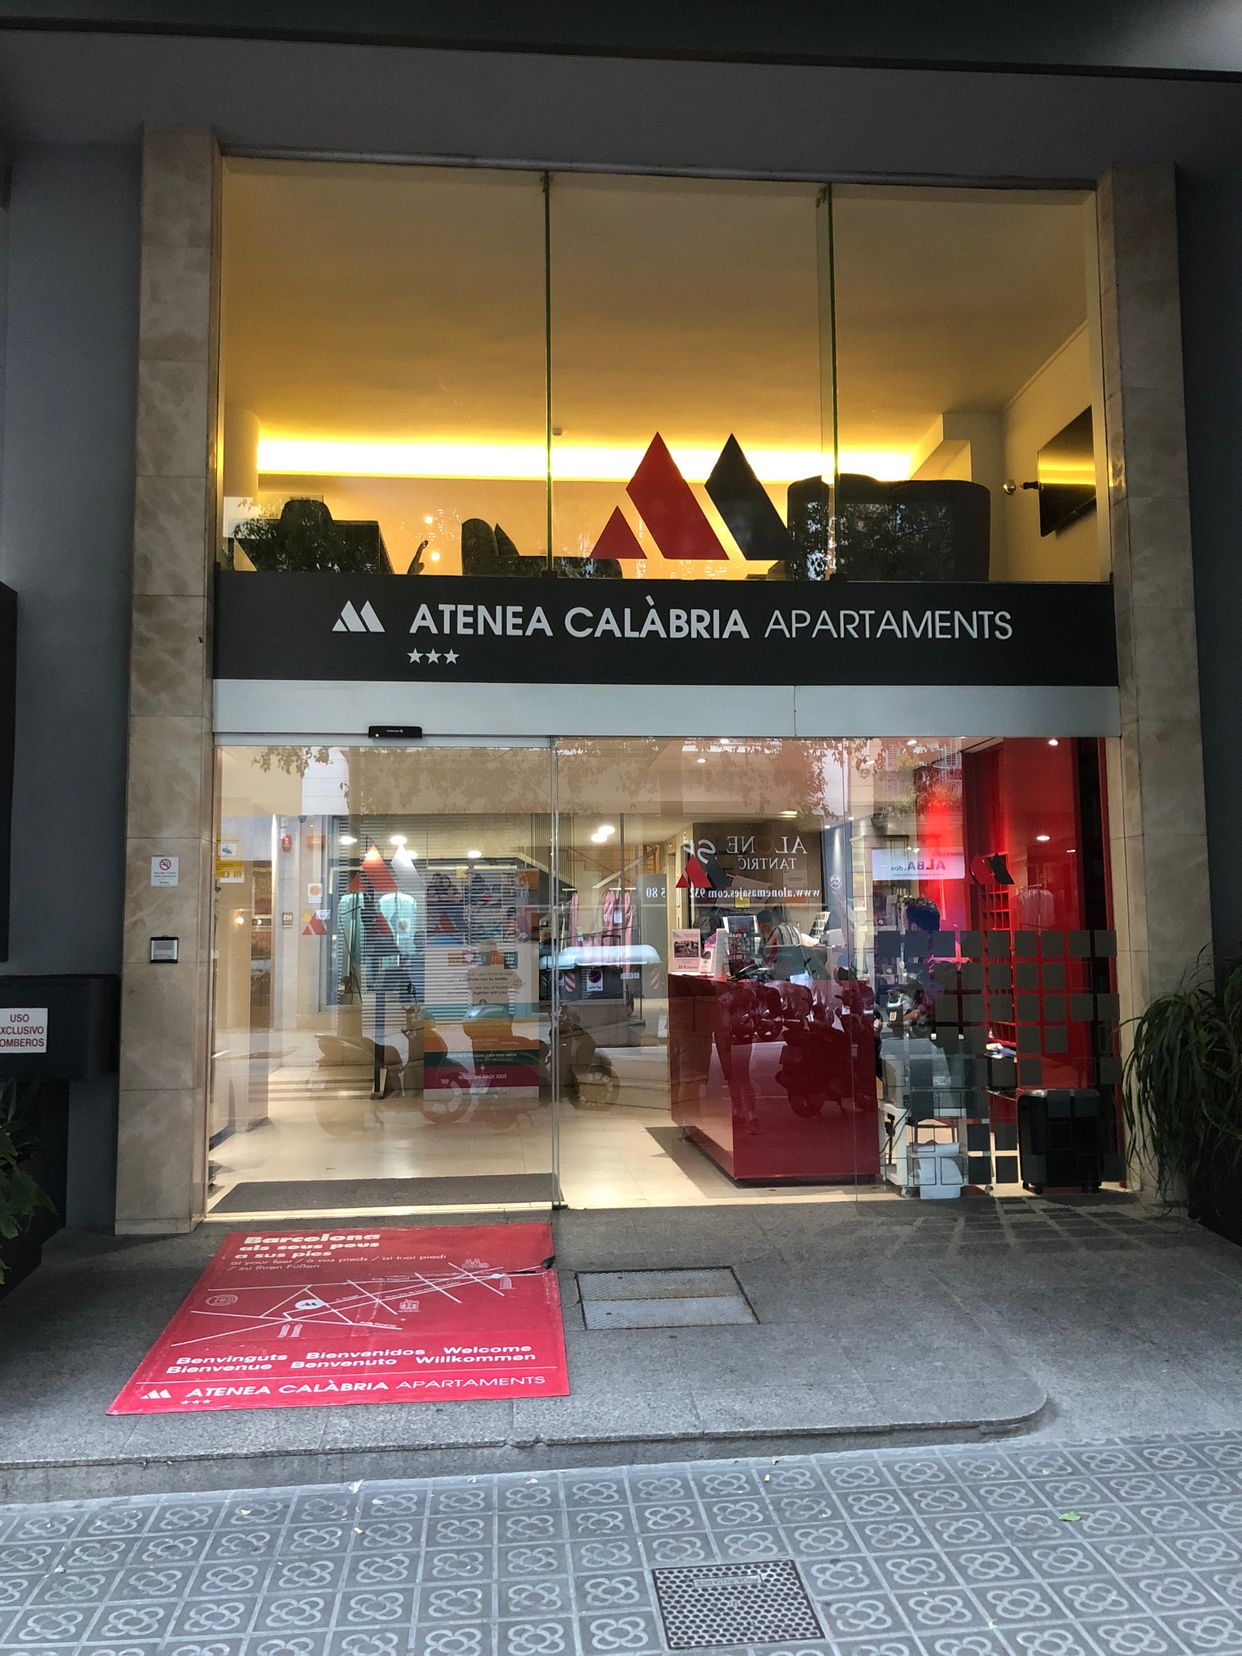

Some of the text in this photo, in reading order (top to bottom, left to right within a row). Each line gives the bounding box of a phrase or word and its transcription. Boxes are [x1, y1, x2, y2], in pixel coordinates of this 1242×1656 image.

[408, 594, 1014, 641] ATENEA CALÀBRIA APARTAMENTS
[10, 1013, 30, 1023] USO
[0, 1026, 44, 1035] XCLUSIVO
[0, 1038, 45, 1047] OMBEROS
[244, 1233, 381, 1244] Barcelona
[176, 1345, 532, 1365] Benvinguts Bienvenidos Welcome
[165, 1353, 537, 1374] Bienvenue Benvenuto Willkommen
[186, 1375, 547, 1398] ATENEA CALÀBRIA APARTAMENTS
